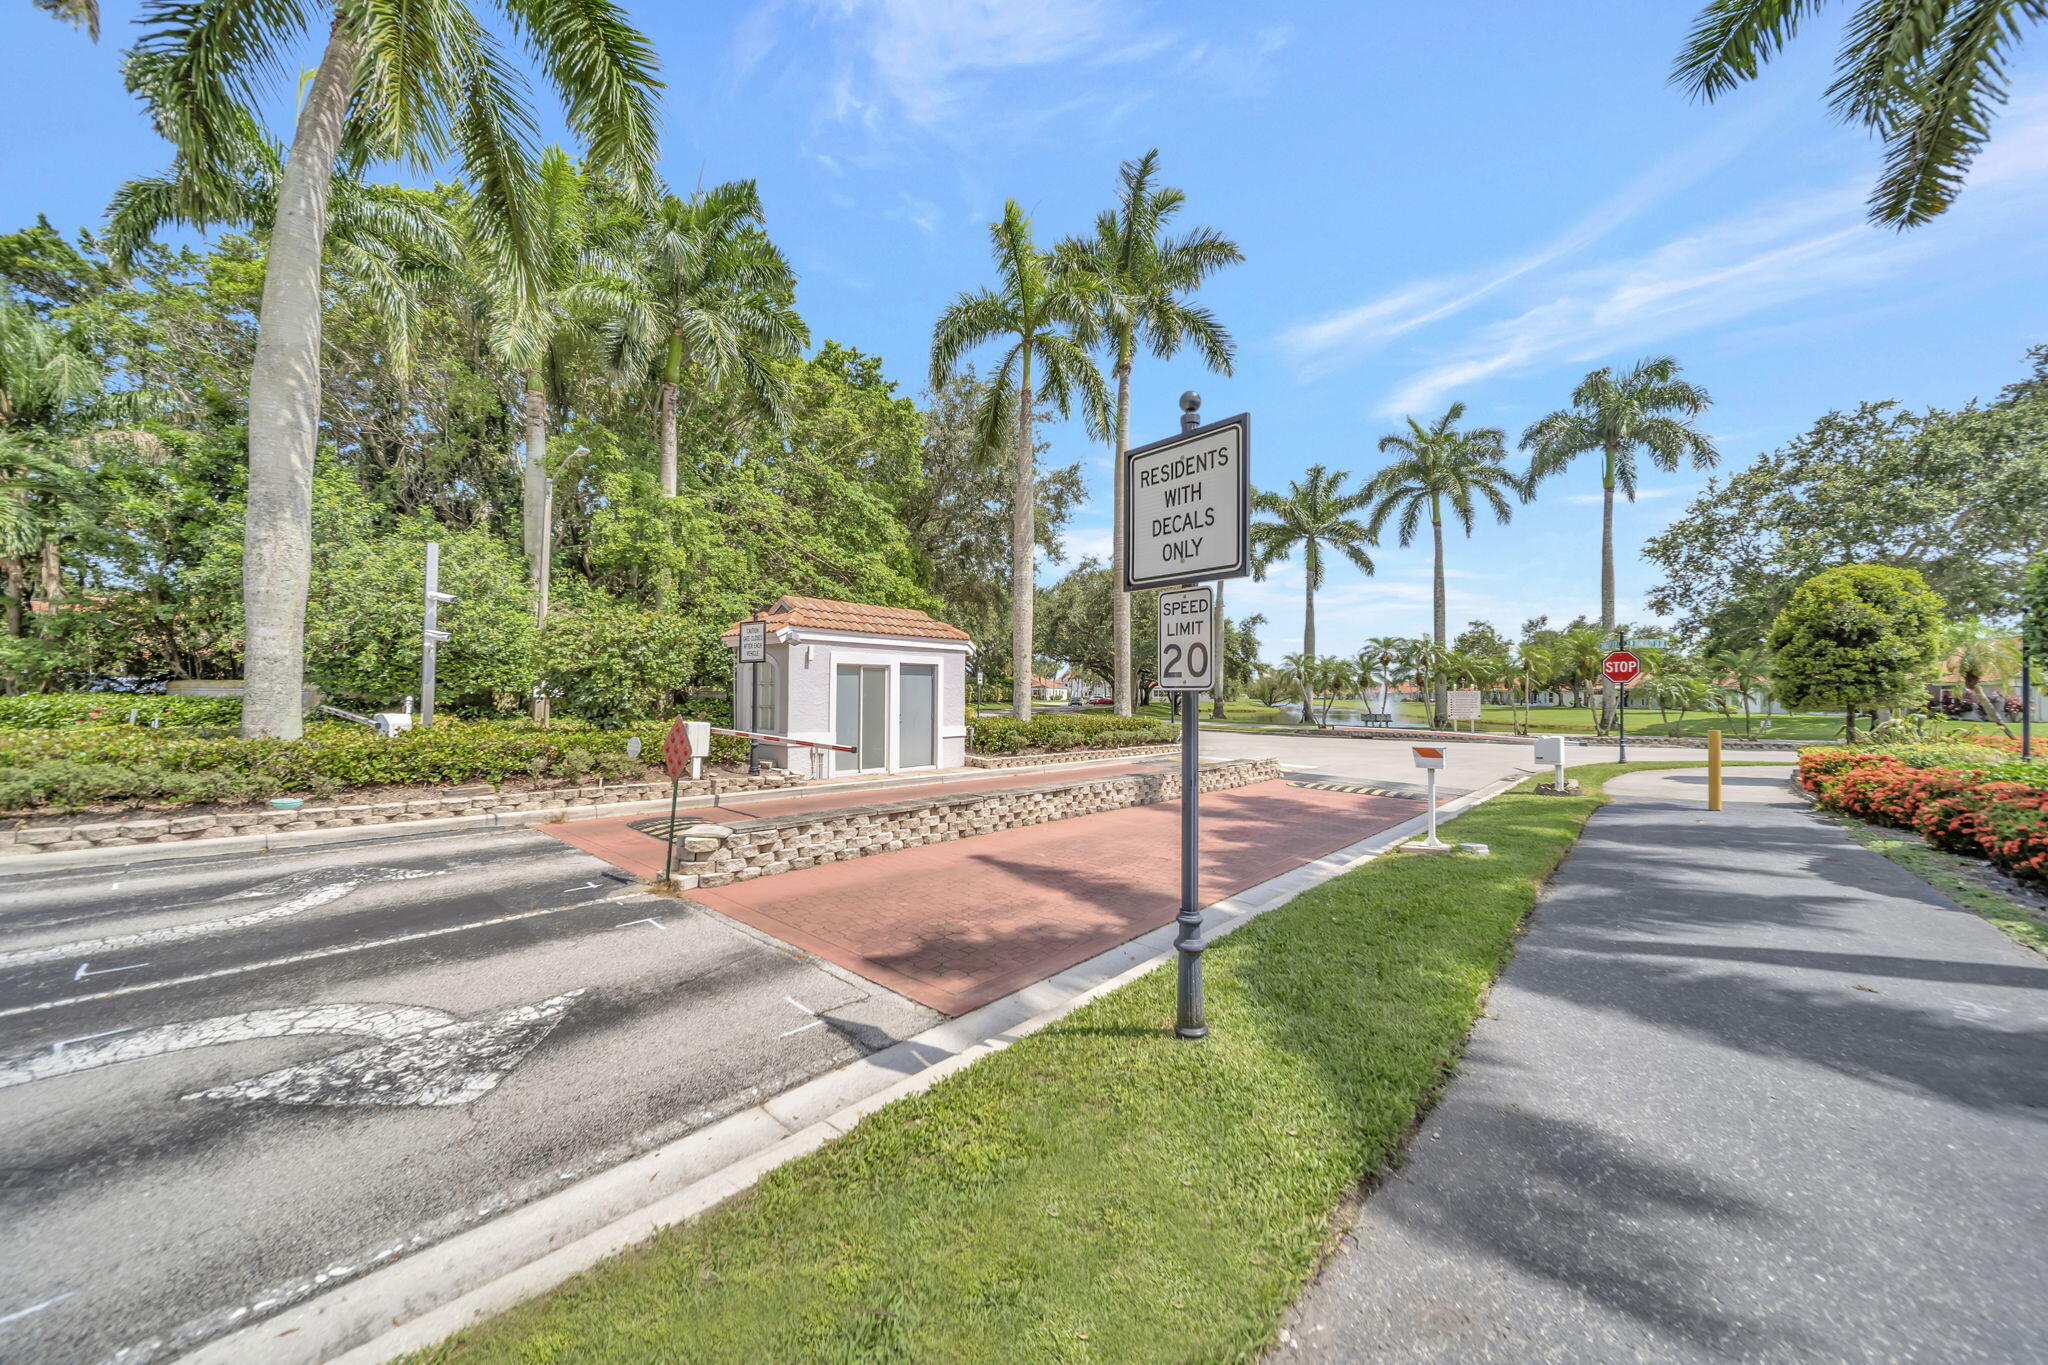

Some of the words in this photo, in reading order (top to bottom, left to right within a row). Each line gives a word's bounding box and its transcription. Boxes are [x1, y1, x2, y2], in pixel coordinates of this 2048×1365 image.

[1140, 446, 1229, 489] RESIDENTS
[1164, 482, 1202, 508] WITH
[1152, 507, 1215, 537] DECALS
[1162, 537, 1203, 561] ONLY
[1163, 599, 1209, 616] SPEED
[1167, 621, 1204, 636] LIMIT
[1163, 642, 1208, 678] 20
[1605, 661, 1637, 673] STOP
